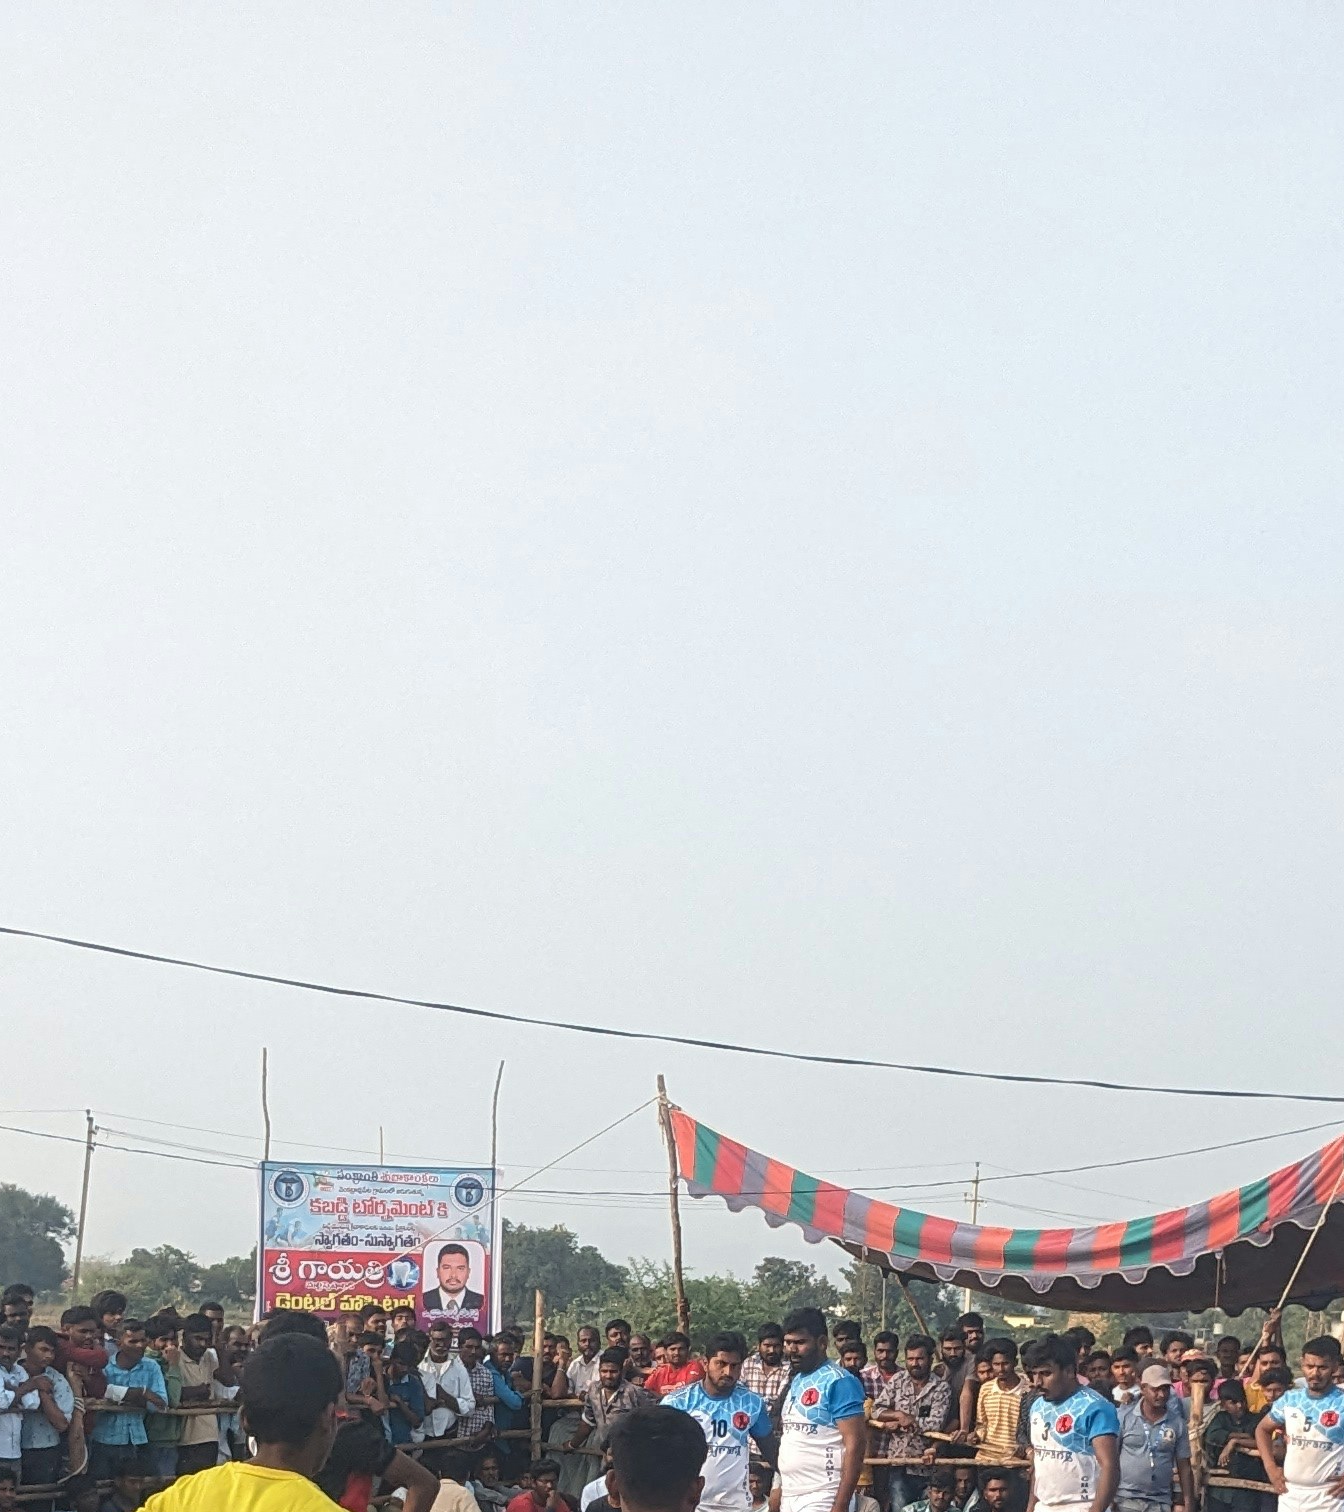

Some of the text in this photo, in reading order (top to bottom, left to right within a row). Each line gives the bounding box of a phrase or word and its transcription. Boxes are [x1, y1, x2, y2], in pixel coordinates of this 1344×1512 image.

[437, 1201, 448, 1217] కి
[269, 1253, 384, 1288] శ్రీ గాయత్రి
[711, 1419, 728, 1438] 10
[1041, 1421, 1051, 1441] 3
[1303, 1416, 1312, 1432] 5
